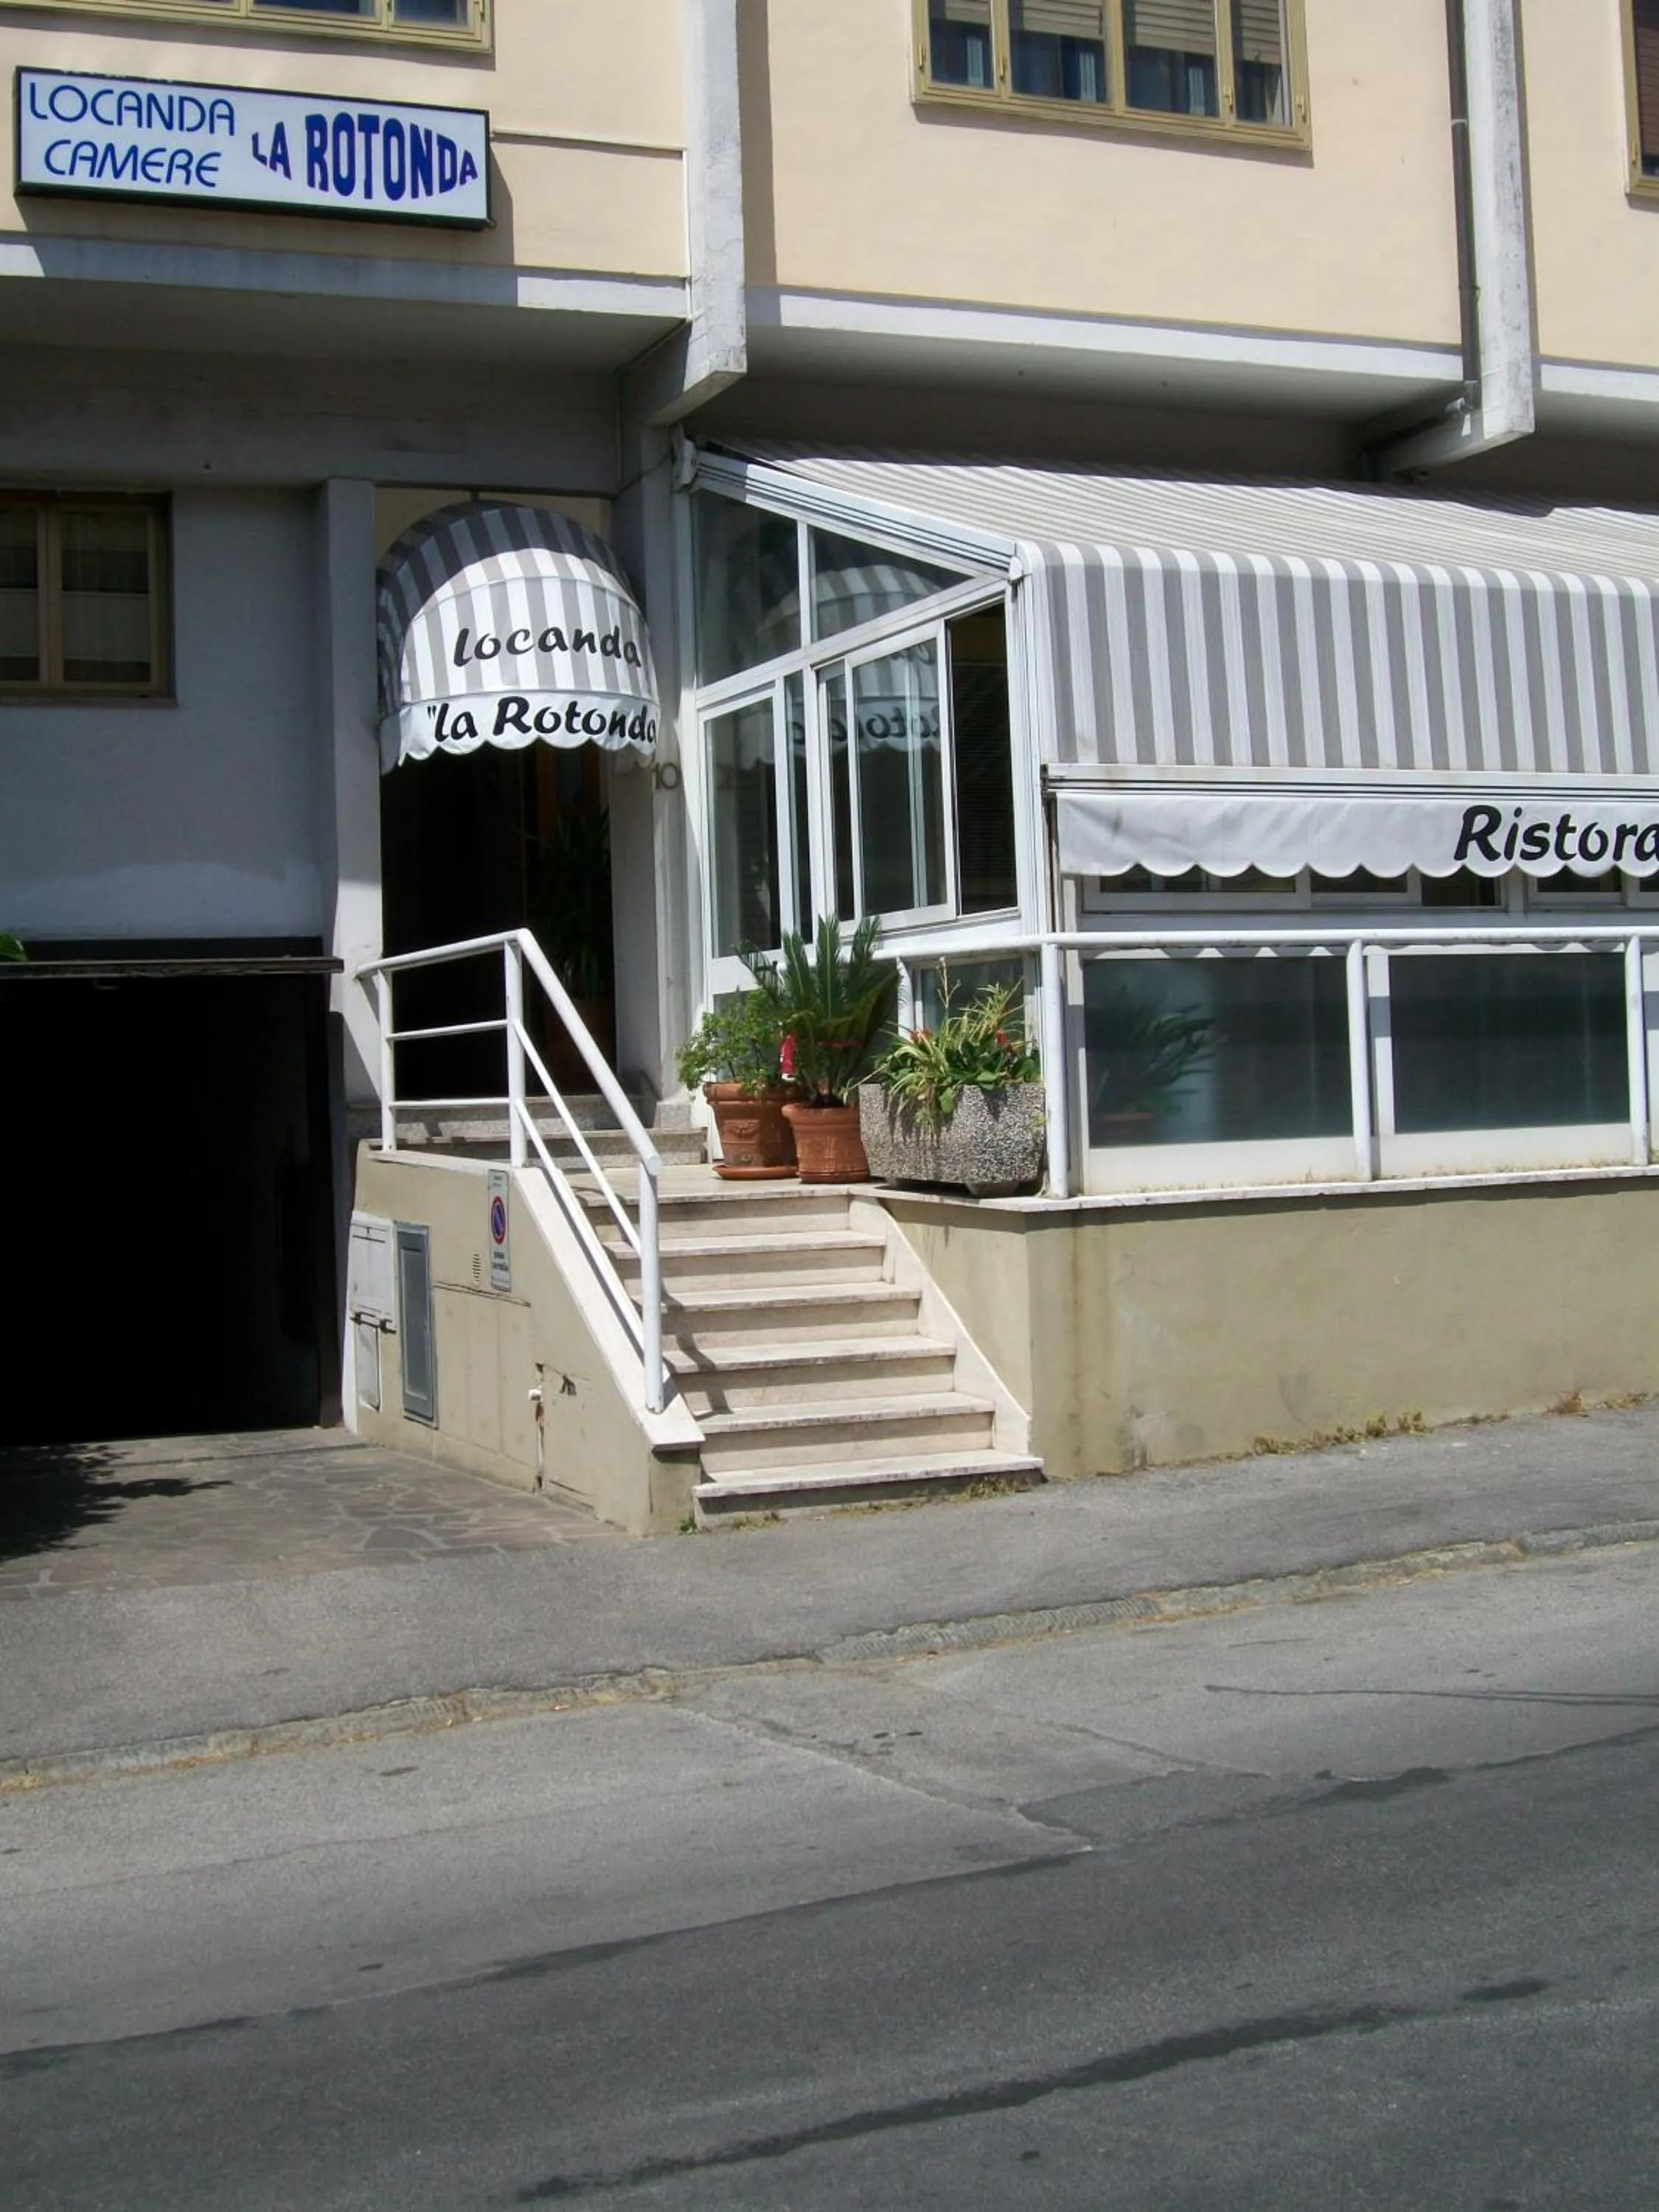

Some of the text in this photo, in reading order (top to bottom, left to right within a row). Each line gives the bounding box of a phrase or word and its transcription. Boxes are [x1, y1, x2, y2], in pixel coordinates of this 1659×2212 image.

[30, 82, 234, 136] LOCANDA
[44, 139, 221, 187] CAMERE
[251, 113, 479, 201] LA ROTONDA
